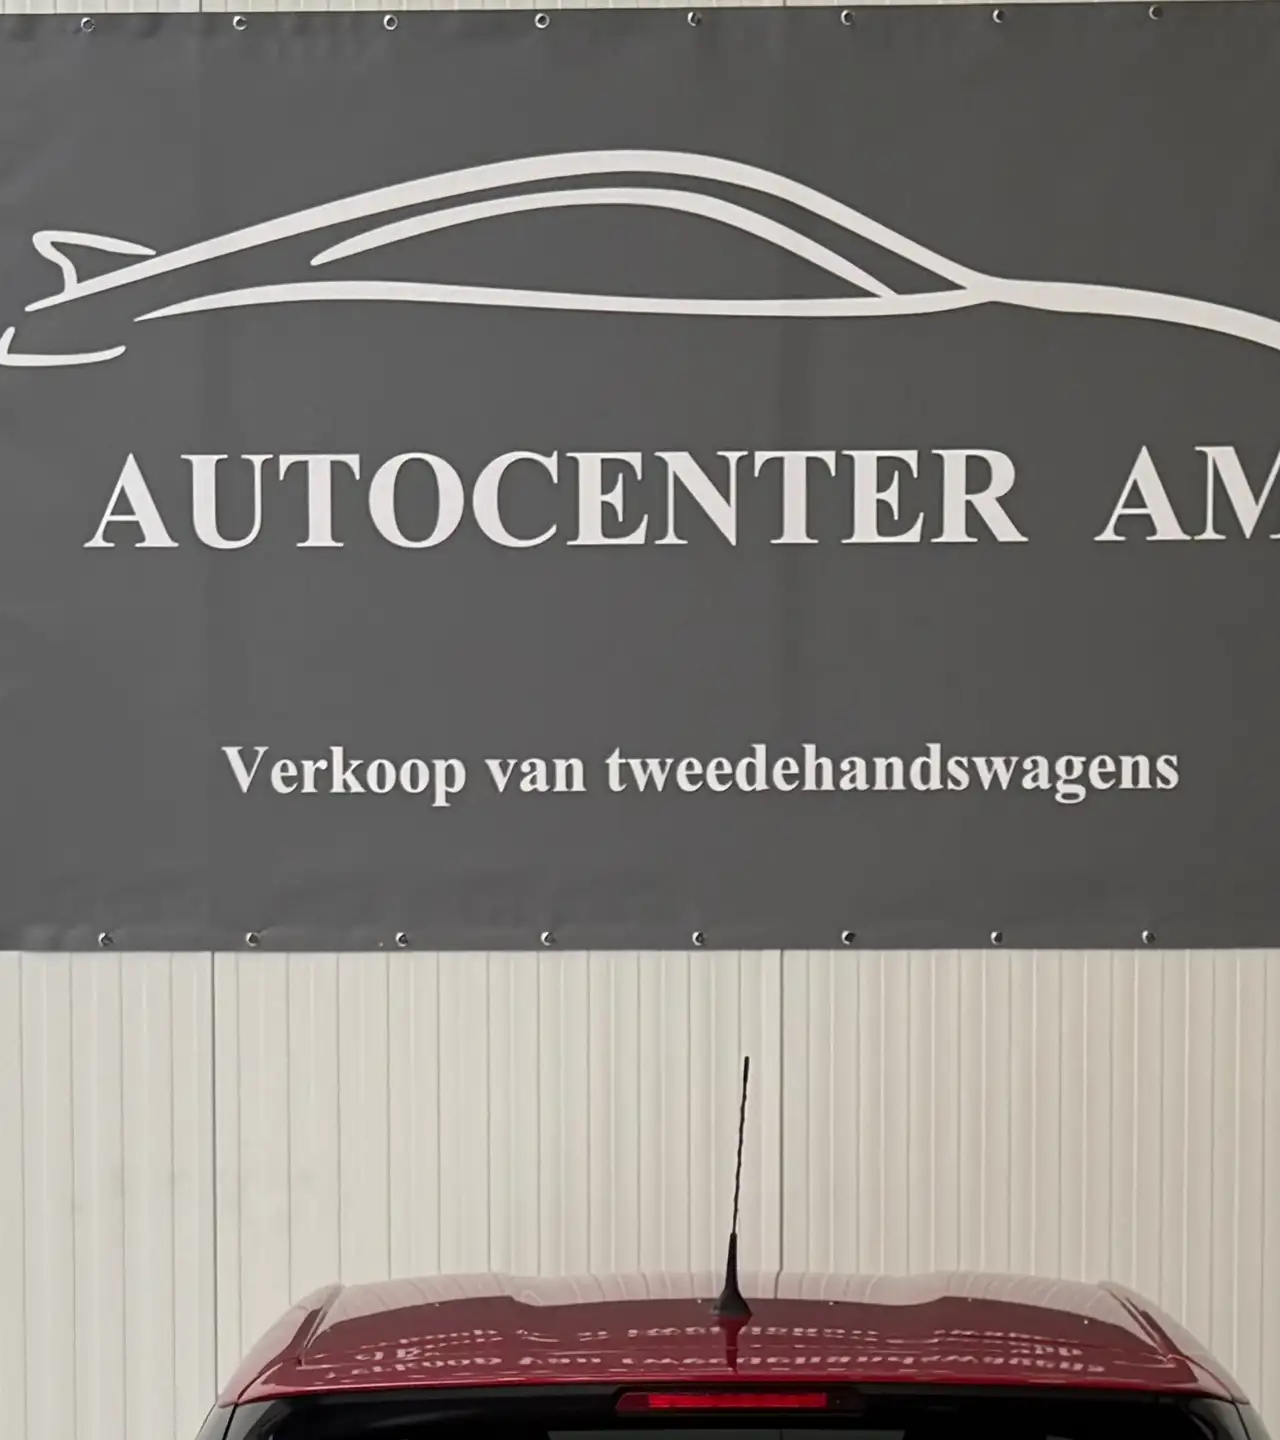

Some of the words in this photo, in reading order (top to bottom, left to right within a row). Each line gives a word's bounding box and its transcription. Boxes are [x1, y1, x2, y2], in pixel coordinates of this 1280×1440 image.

[83, 448, 1029, 550] AUTOCENTER
[221, 745, 467, 807] Verkoop
[484, 757, 587, 793] van
[604, 742, 1179, 804] tweedehandswagens
